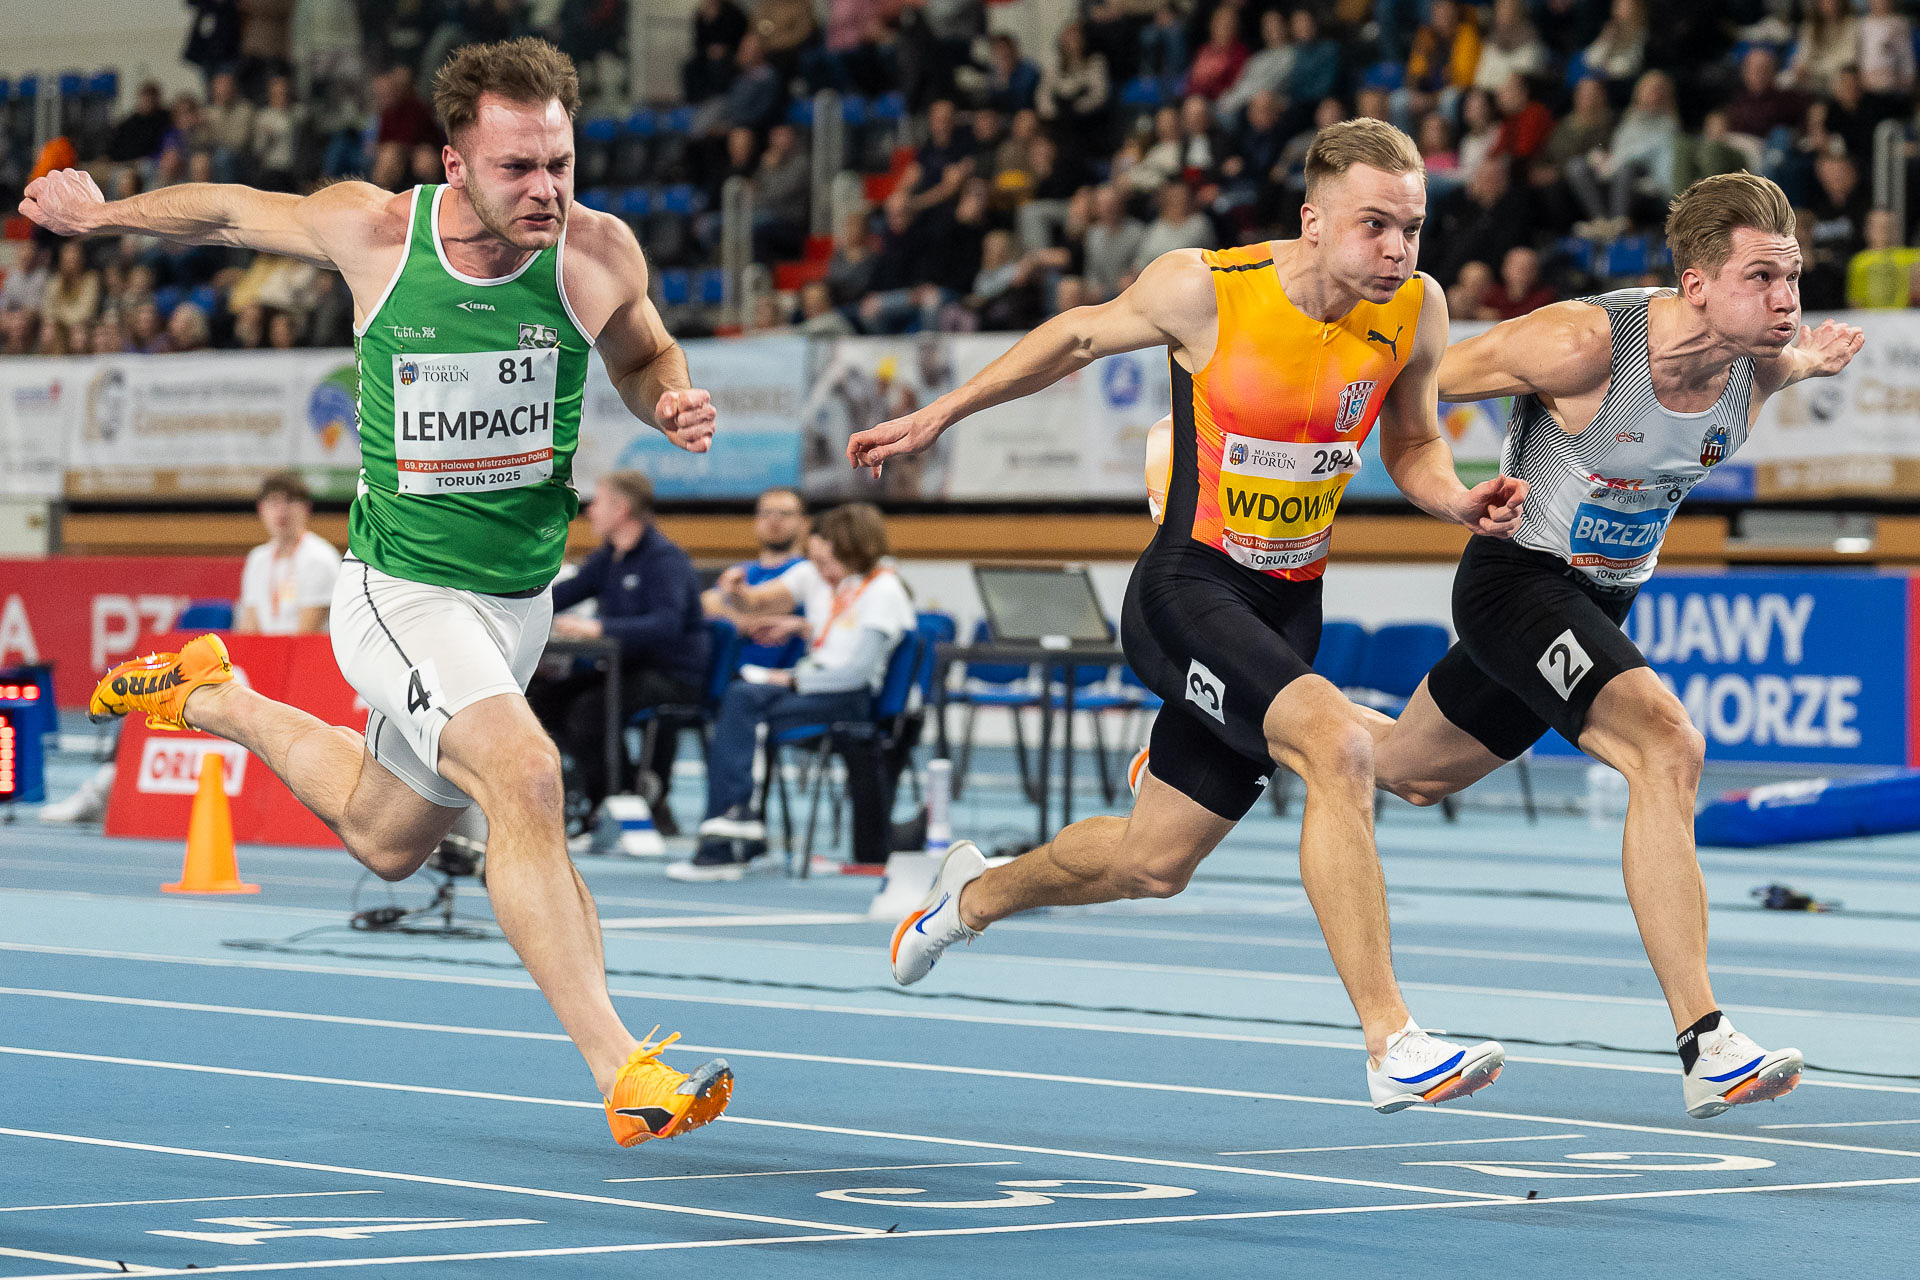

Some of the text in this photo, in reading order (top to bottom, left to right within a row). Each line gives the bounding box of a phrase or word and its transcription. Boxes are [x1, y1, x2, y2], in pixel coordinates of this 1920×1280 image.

[422, 369, 469, 382] TORUŃ
[498, 357, 536, 384] 81
[402, 402, 549, 441] LEMPACH
[404, 450, 549, 471] 69. PZLA Halowe Mistrzostwa Polski
[1251, 455, 1296, 470] TORUŃ
[1254, 449, 1288, 458] MIASTO
[1310, 449, 1354, 474] 284
[436, 471, 521, 487] TORUŃ 2025
[1226, 485, 1342, 524] WDOWIK
[1250, 550, 1313, 565] TORUŃ 2025
[1548, 642, 1585, 690] 2
[112, 663, 190, 697] NITRO
[408, 669, 432, 715] 4
[1189, 672, 1220, 711] 3
[1399, 1151, 1777, 1178] 2
[816, 1179, 1198, 1208] 3
[144, 1216, 548, 1245] 4
